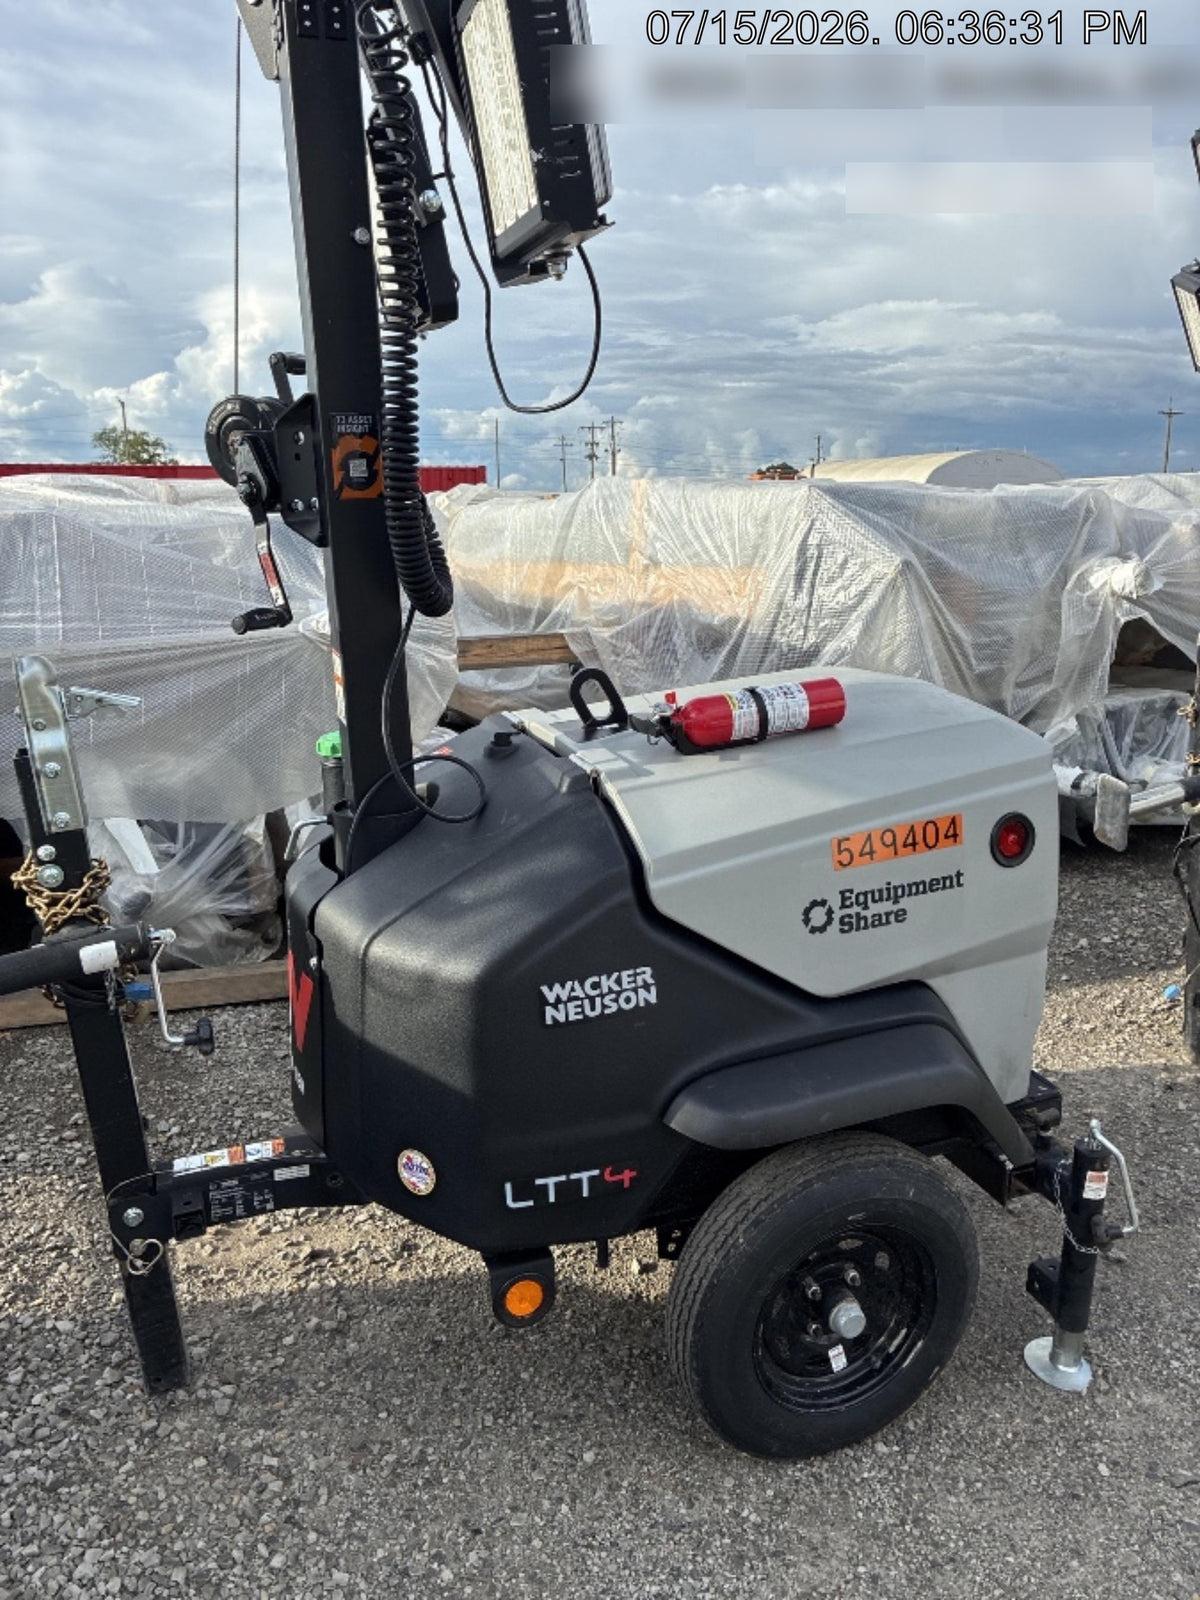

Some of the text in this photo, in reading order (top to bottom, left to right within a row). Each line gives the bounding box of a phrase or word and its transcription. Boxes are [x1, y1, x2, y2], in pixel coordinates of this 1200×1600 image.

[836, 815, 959, 868] 549404
[839, 869, 964, 910] Equipment
[839, 907, 907, 934] Share
[540, 966, 656, 1004] WACKER
[545, 985, 657, 1025] NEUSON
[504, 1166, 637, 1209] LTT4
